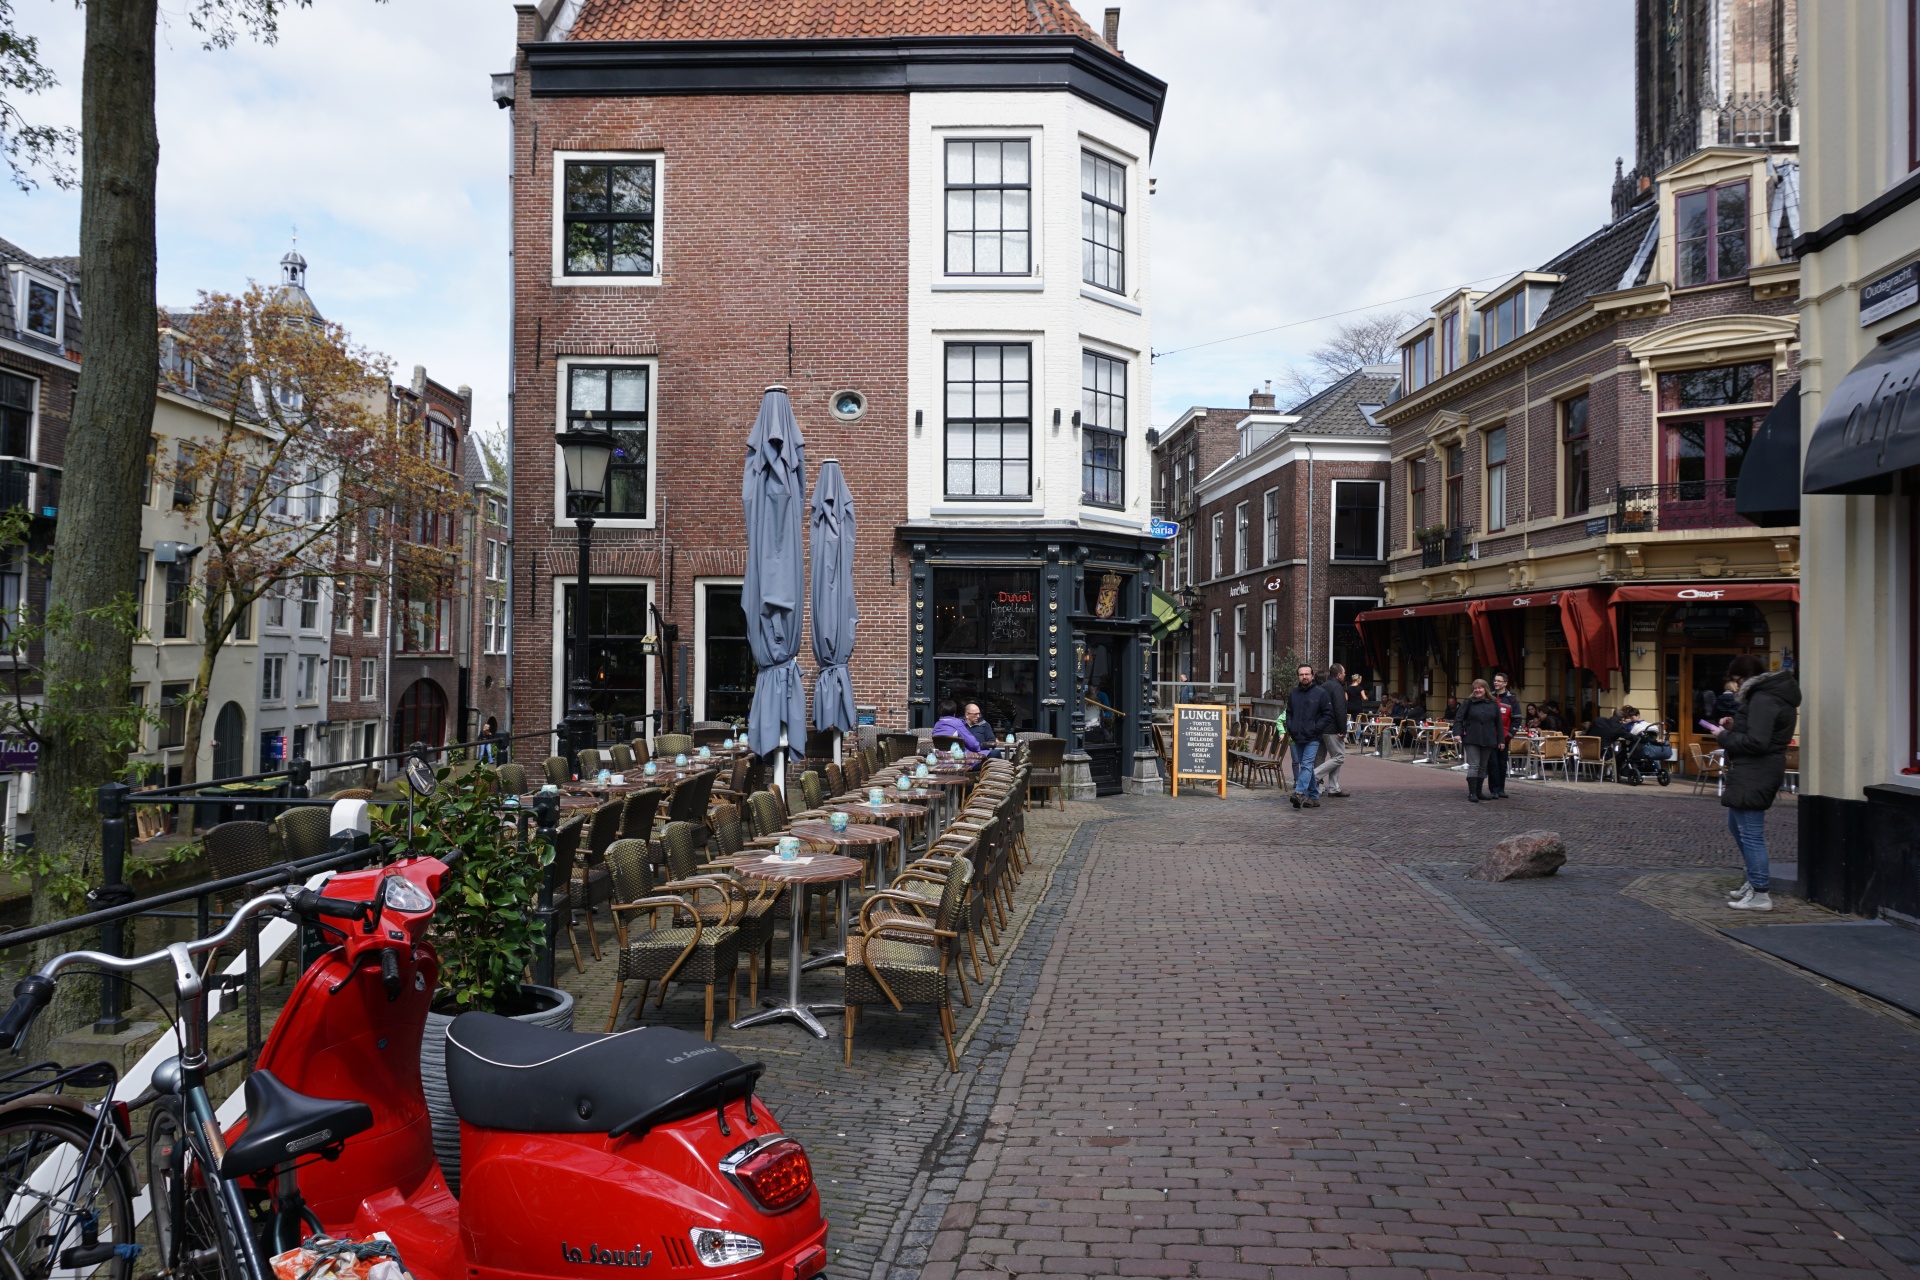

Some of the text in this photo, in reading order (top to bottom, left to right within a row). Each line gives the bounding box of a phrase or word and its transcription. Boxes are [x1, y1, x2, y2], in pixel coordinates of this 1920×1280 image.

[1864, 267, 1912, 299] Oudegracht
[998, 591, 1032, 602] Duvel
[990, 601, 1035, 617] Appeltaart
[1181, 710, 1219, 720] LUNCH
[682, 1046, 717, 1058] Souris
[561, 1241, 653, 1267] La Souris
